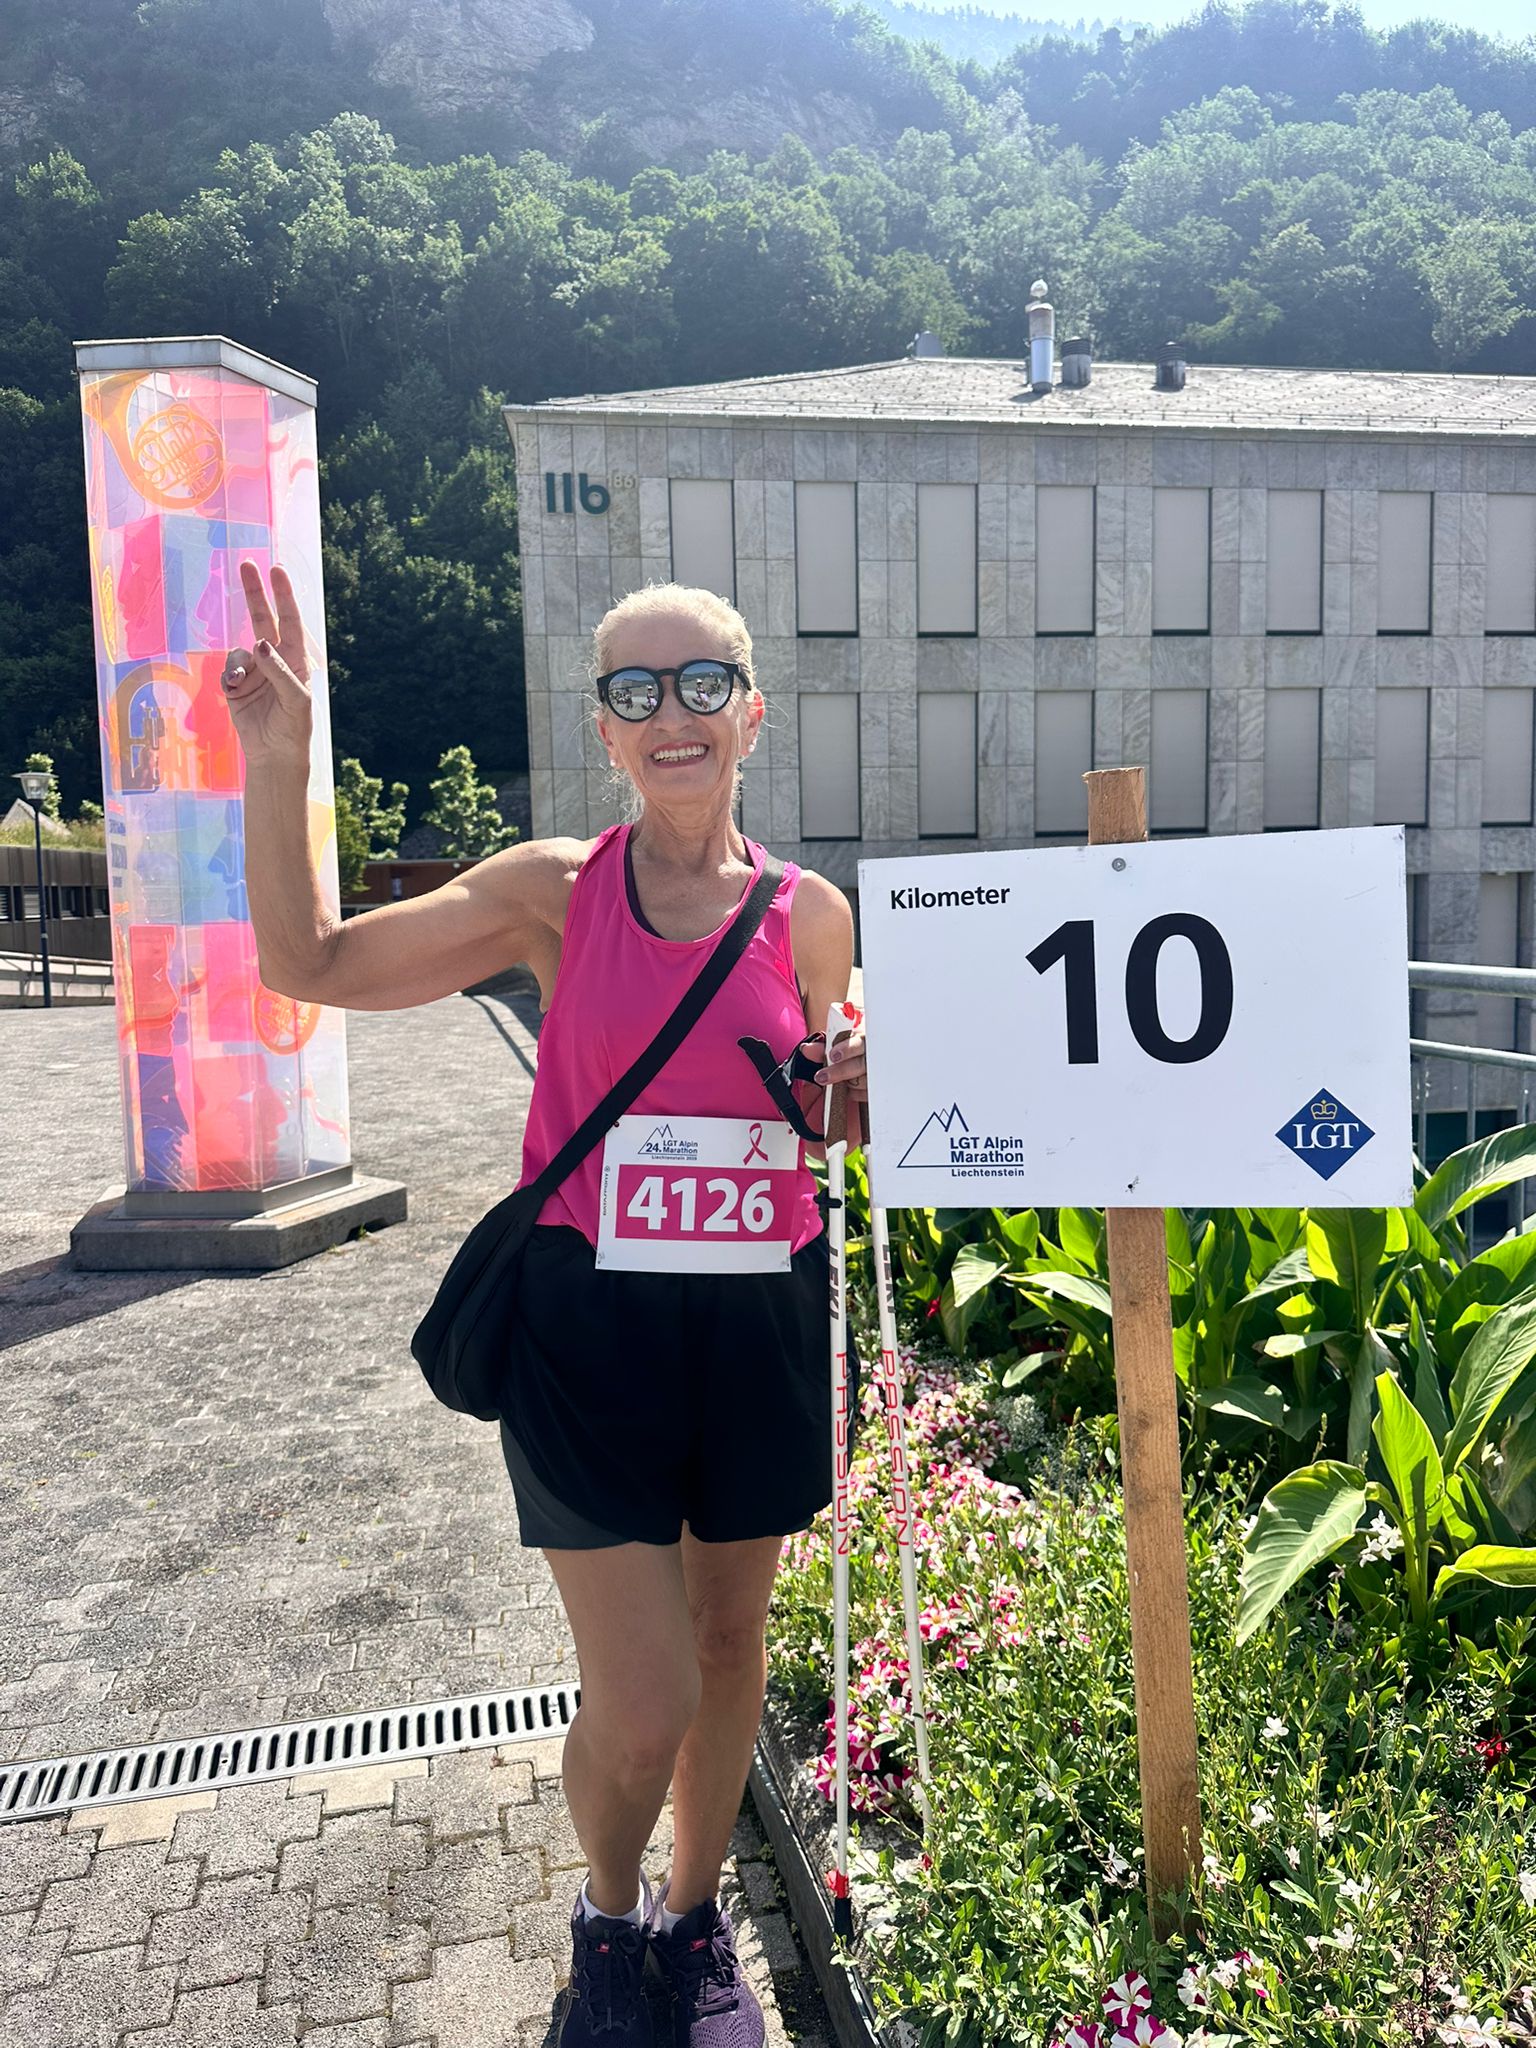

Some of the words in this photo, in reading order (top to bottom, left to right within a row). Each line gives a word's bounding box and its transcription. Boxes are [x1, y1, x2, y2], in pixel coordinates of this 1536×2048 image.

[890, 886, 1010, 910] Kilometer
[1025, 912, 1233, 1065] 10
[645, 1142, 662, 1153] 24.
[679, 1140, 699, 1148] Alpin
[950, 1136, 980, 1149] LGT
[983, 1136, 1023, 1151] Alpin
[1292, 1122, 1360, 1149] LGT
[950, 1150, 1024, 1163] Marathon
[951, 1168, 1025, 1177] Liechtenstein
[626, 1176, 775, 1233] 4126
[836, 1352, 848, 1555] PASSION
[882, 1349, 910, 1546] PASSION
